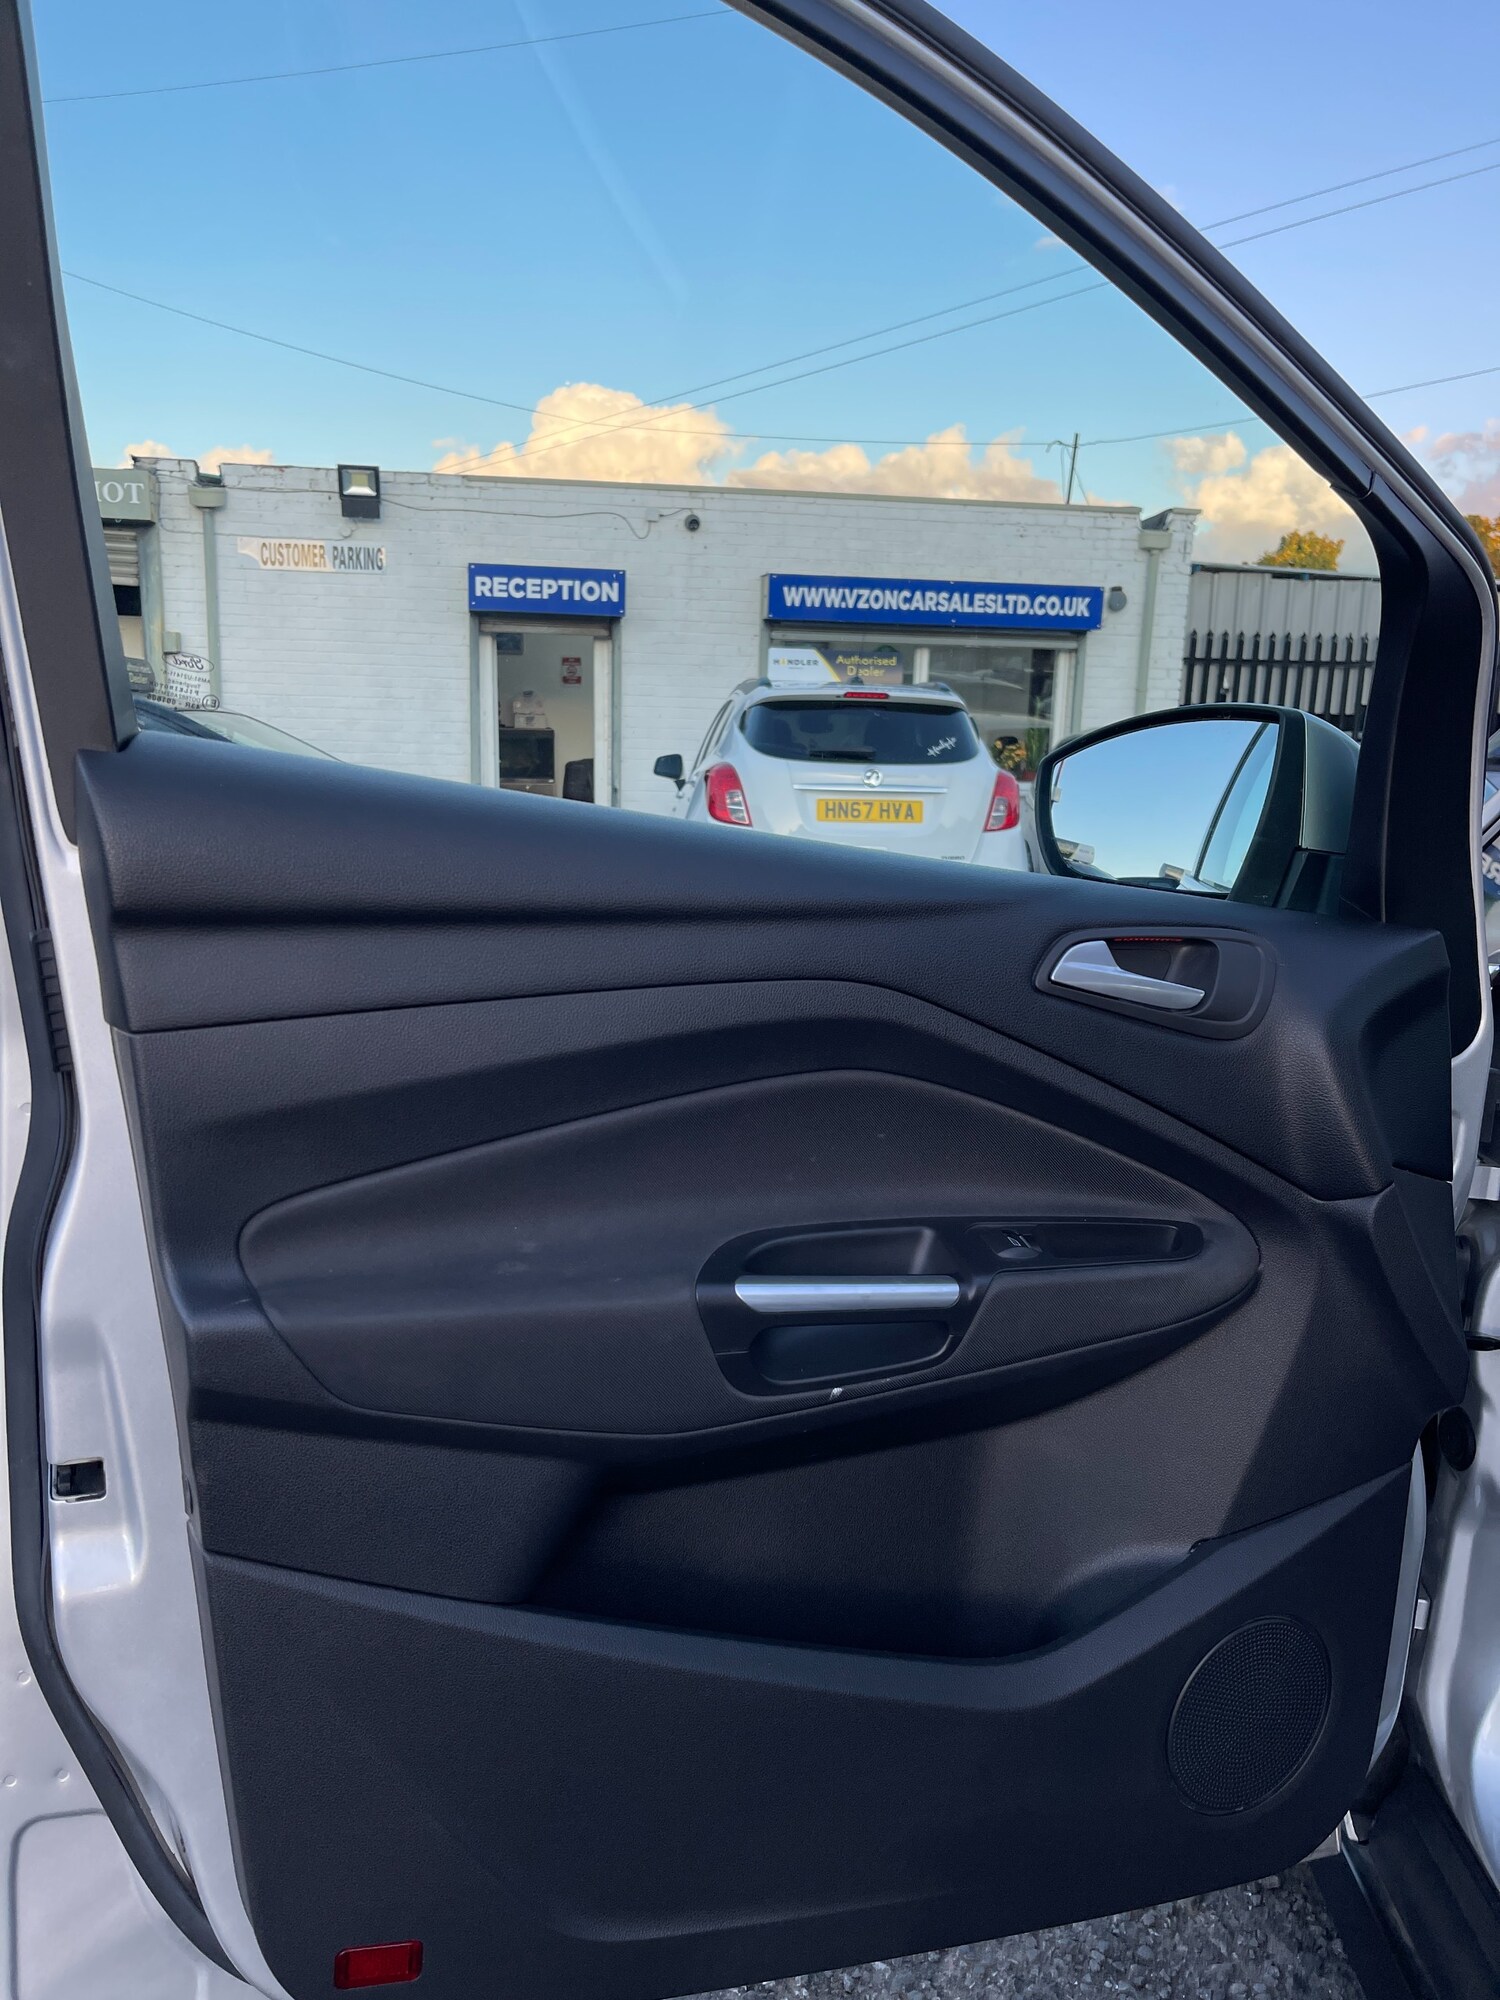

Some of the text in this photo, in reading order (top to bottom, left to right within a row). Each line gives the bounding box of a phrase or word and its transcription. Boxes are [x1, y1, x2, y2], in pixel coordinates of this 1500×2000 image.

[95, 480, 145, 504] OT
[260, 542, 384, 571] CUSTOMER PARKING
[474, 576, 620, 602] RECEPTION
[782, 585, 1091, 617] WWW.VZONCARSALESLTD.CO.UK
[836, 655, 898, 666] Authorised
[847, 665, 885, 677] Dealer
[824, 801, 914, 820] HN67 HVA
